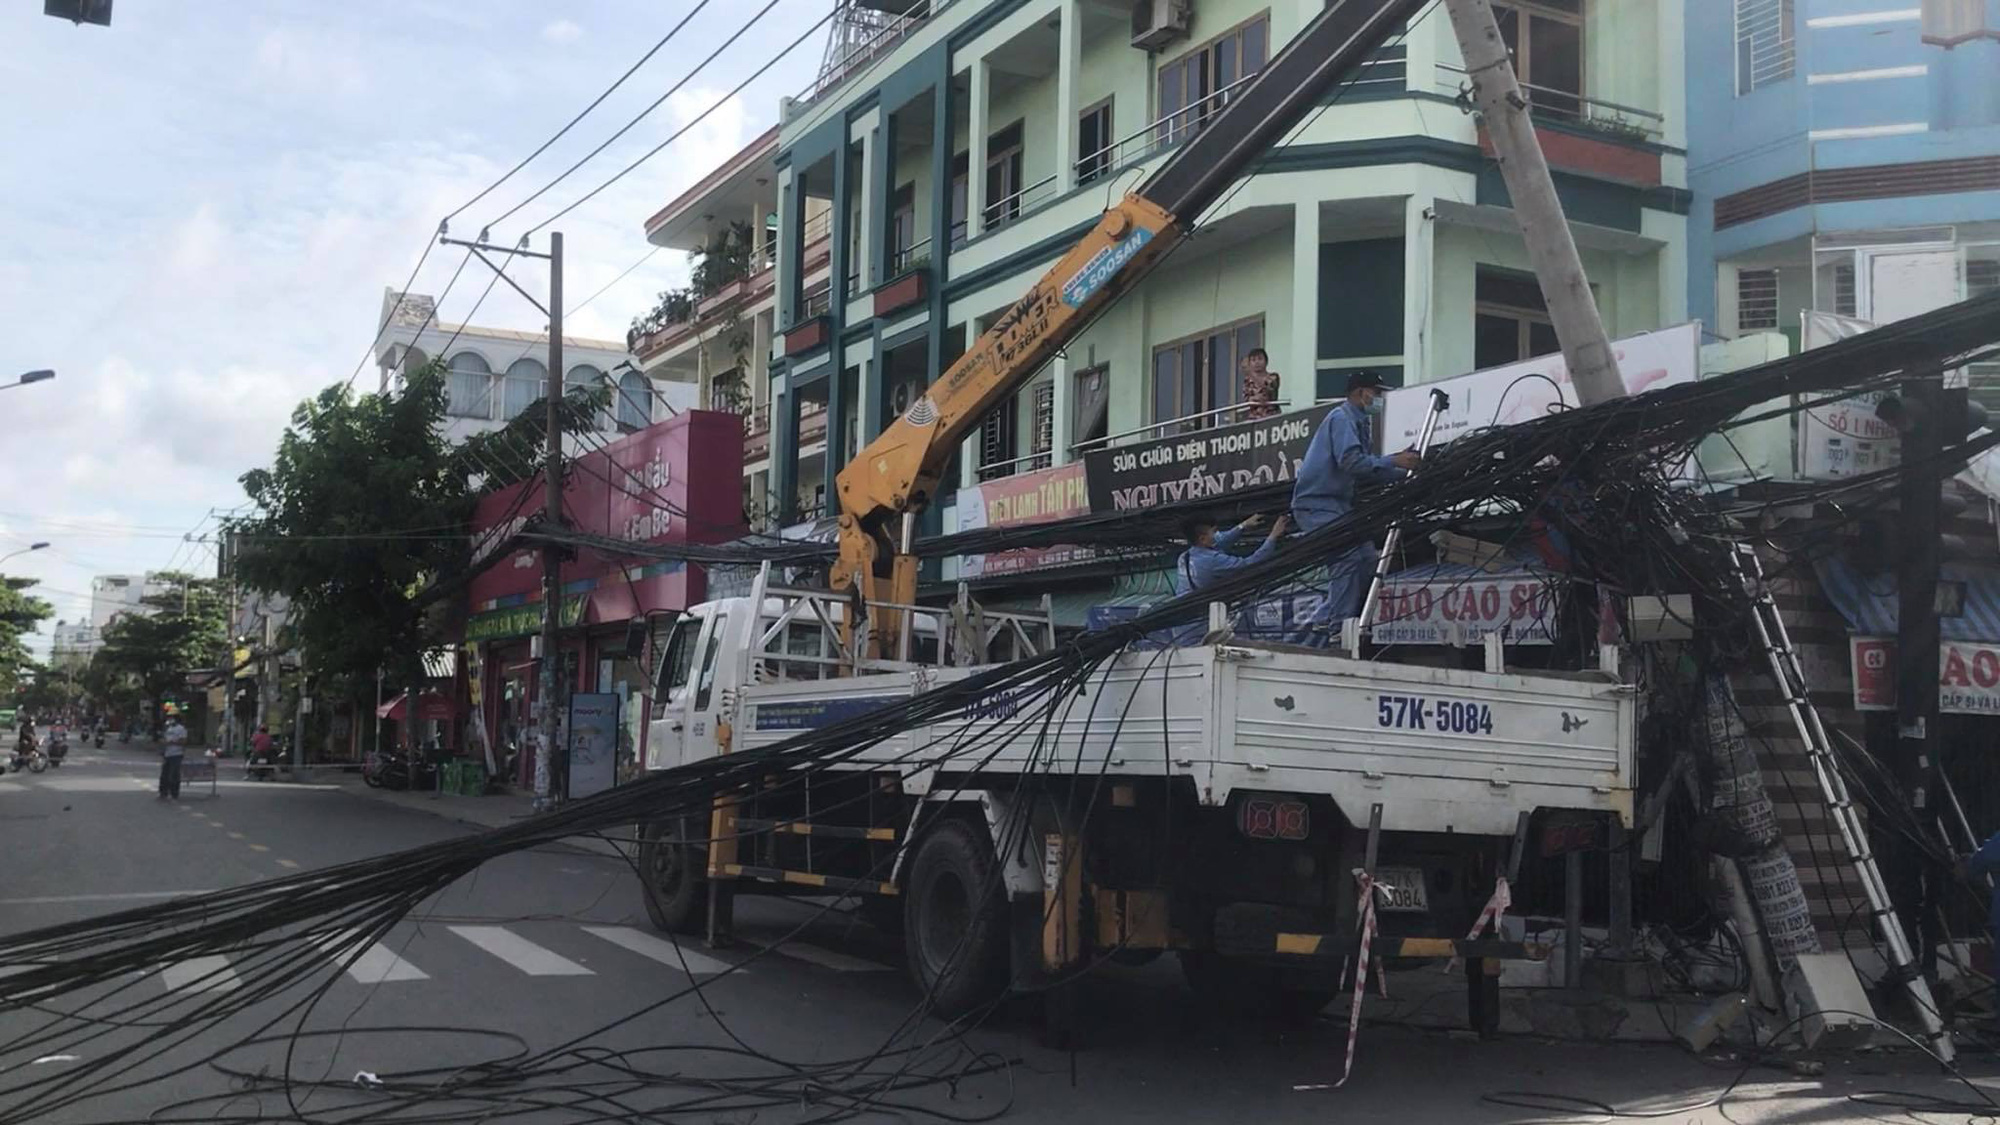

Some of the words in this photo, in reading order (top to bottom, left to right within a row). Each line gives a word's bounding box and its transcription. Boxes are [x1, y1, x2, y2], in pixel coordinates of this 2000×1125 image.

[1089, 232, 1142, 288] SOOSAN
[1177, 439, 1206, 464] ĐIỆN
[1210, 432, 1251, 456] THOẠI
[1254, 428, 1268, 448] DI
[1271, 419, 1310, 447] ĐỘNG
[1440, 585, 1501, 622] CAO
[1378, 695, 1493, 735] 57K-5084
